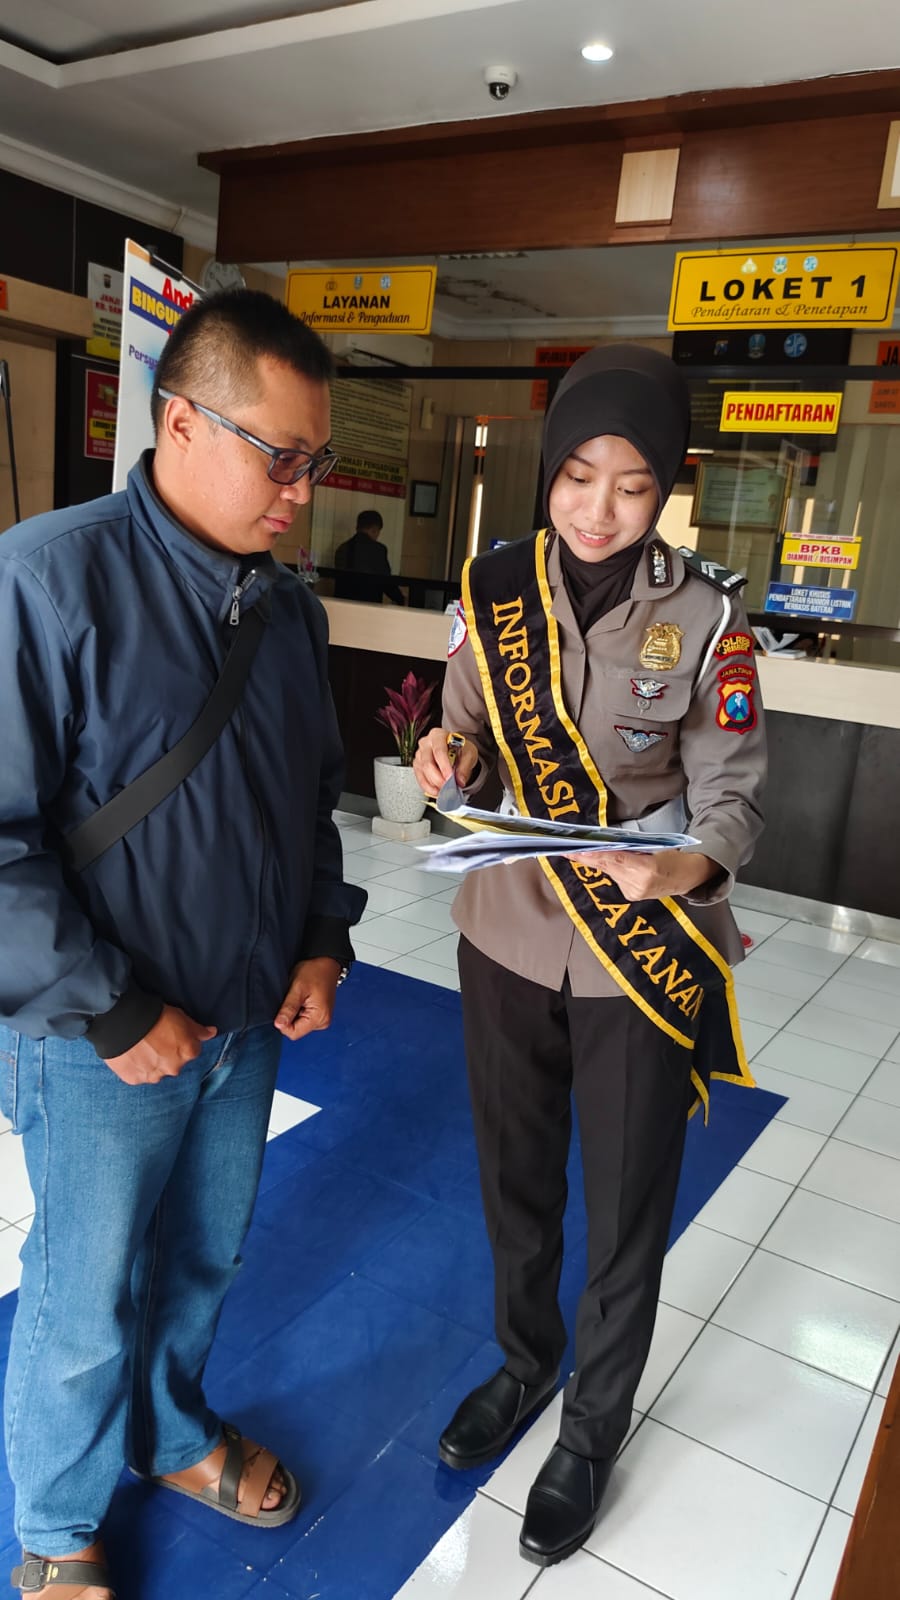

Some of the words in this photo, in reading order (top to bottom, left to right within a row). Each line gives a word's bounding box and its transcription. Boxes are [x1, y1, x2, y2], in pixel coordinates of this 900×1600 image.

[700, 276, 832, 301] LOKET
[851, 275, 866, 298] 1
[323, 296, 390, 309] LAYANAN
[301, 311, 346, 326] Informasi
[347, 311, 355, 323] &
[357, 311, 411, 326] Pengaduan
[691, 304, 770, 320] Pendaftaran
[775, 303, 791, 316] &
[794, 302, 868, 318] Penetapan
[725, 403, 836, 422] PENDAFTARAN
[787, 553, 813, 562] DIAMBIL
[800, 544, 841, 555] BPKB
[491, 597, 580, 822] INFORMASI
[569, 860, 704, 1022] ELAYANAN
